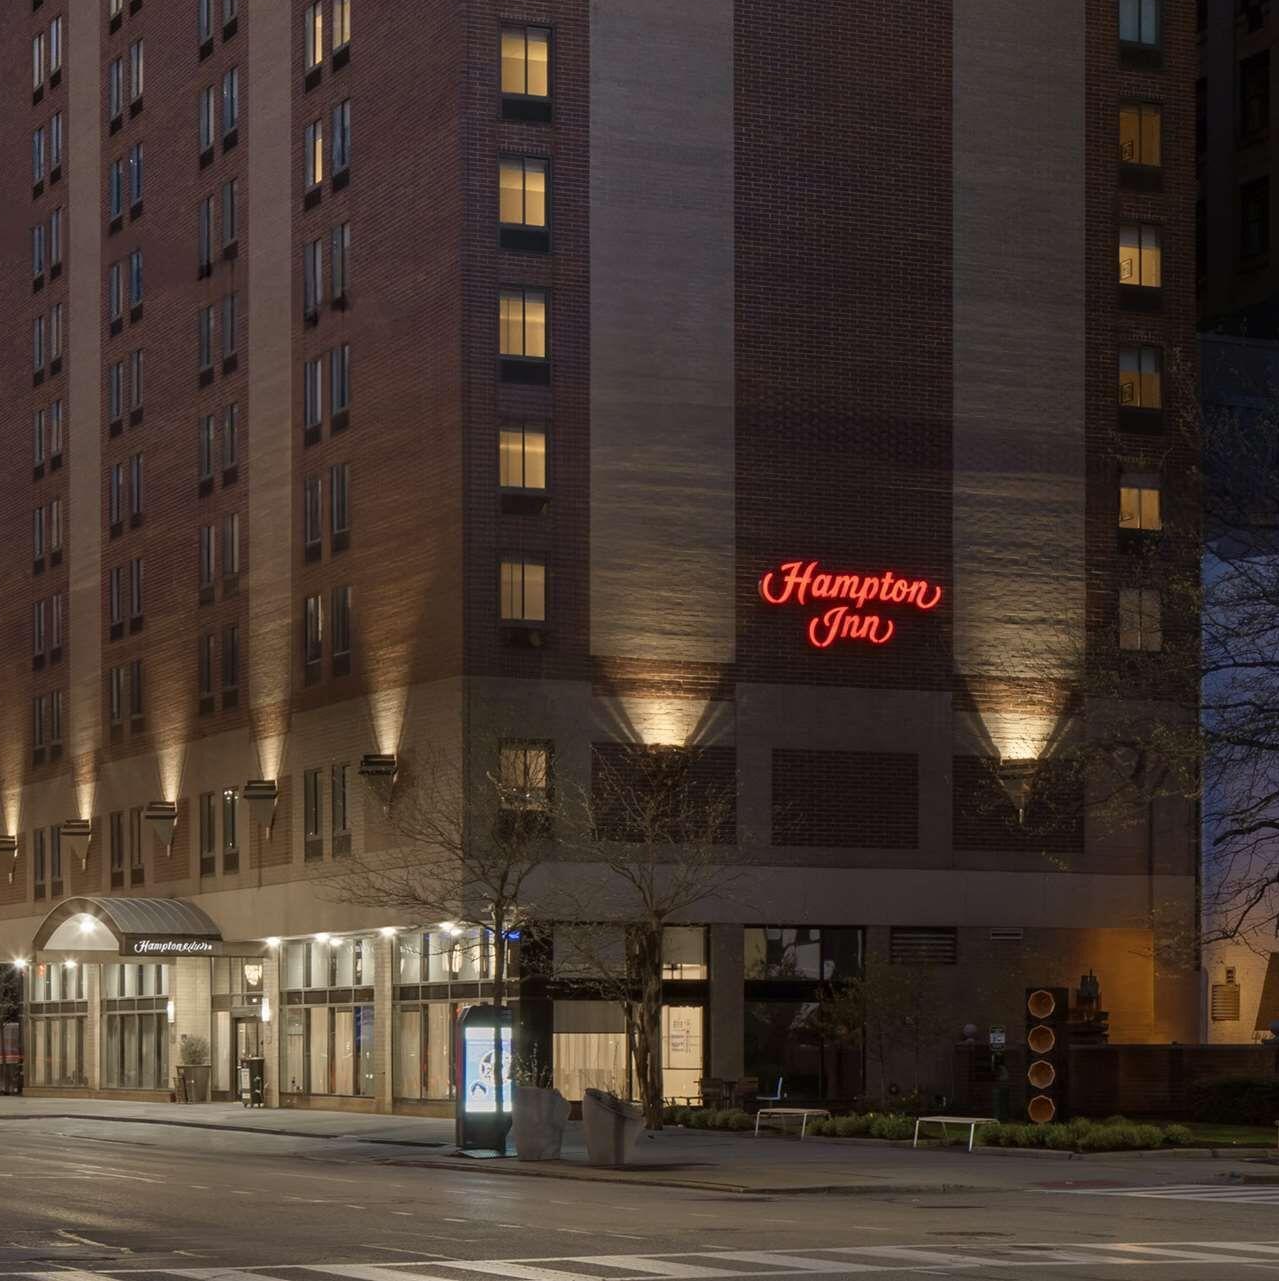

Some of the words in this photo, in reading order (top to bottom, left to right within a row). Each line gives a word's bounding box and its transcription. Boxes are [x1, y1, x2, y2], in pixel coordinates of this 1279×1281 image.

[760, 560, 942, 609] Hampton
[808, 605, 894, 649] Inn
[134, 939, 185, 953] Hampton
